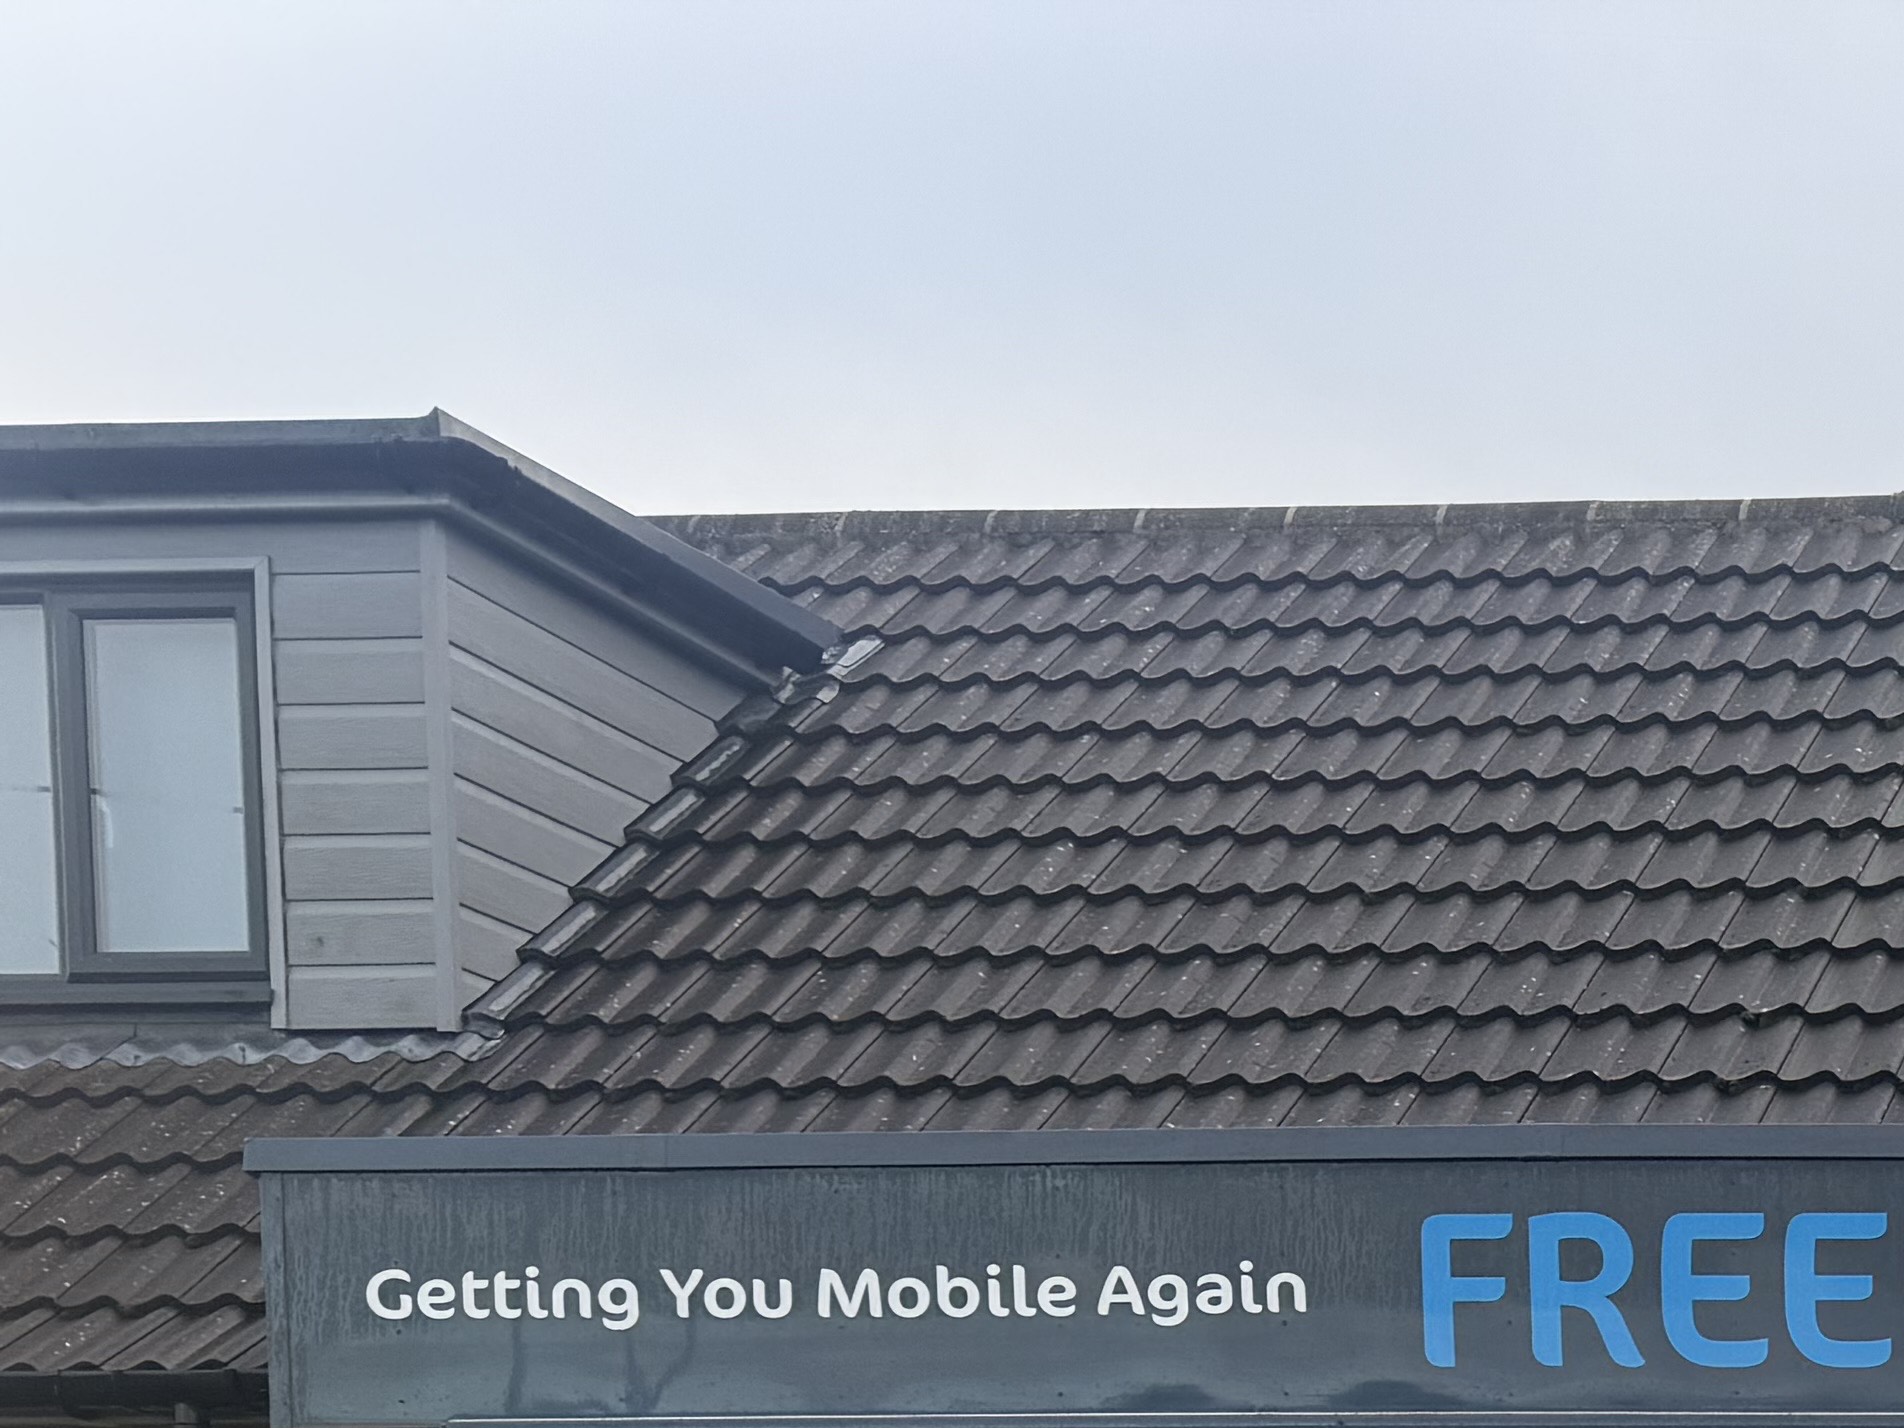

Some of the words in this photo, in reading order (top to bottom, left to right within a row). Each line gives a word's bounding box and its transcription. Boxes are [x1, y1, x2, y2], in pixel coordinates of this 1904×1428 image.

[366, 1266, 639, 1330] Getting
[660, 1269, 792, 1318] You
[818, 1264, 1076, 1318] Mobile
[1098, 1261, 1306, 1326] Again
